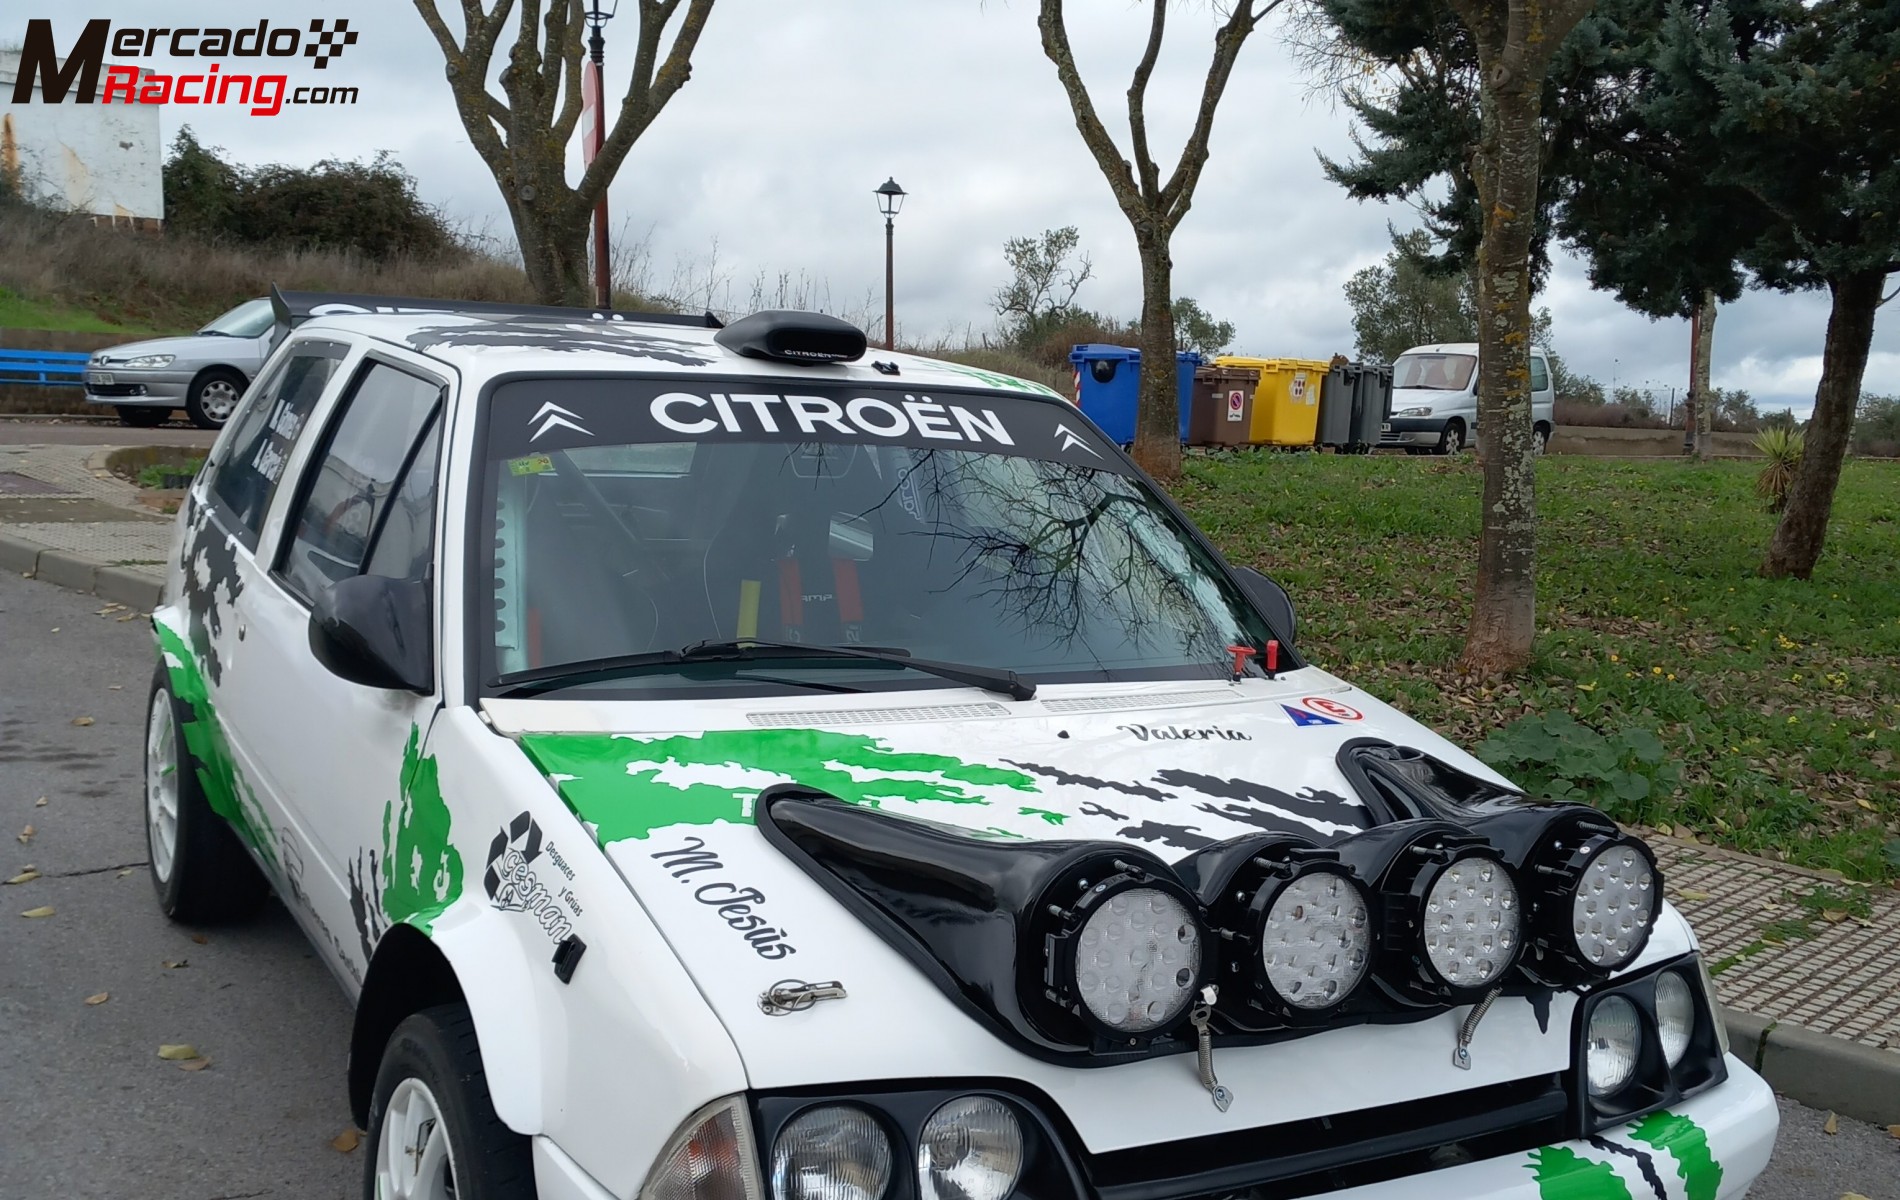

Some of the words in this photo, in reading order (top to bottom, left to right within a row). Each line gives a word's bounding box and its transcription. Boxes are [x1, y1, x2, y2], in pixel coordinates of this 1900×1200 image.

[649, 391, 1015, 446] CITROËN
[1115, 723, 1252, 741] Valeria
[545, 841, 576, 881] Desguaces
[558, 886, 567, 897] y
[650, 836, 724, 884] M.
[694, 882, 797, 960] Jesús
